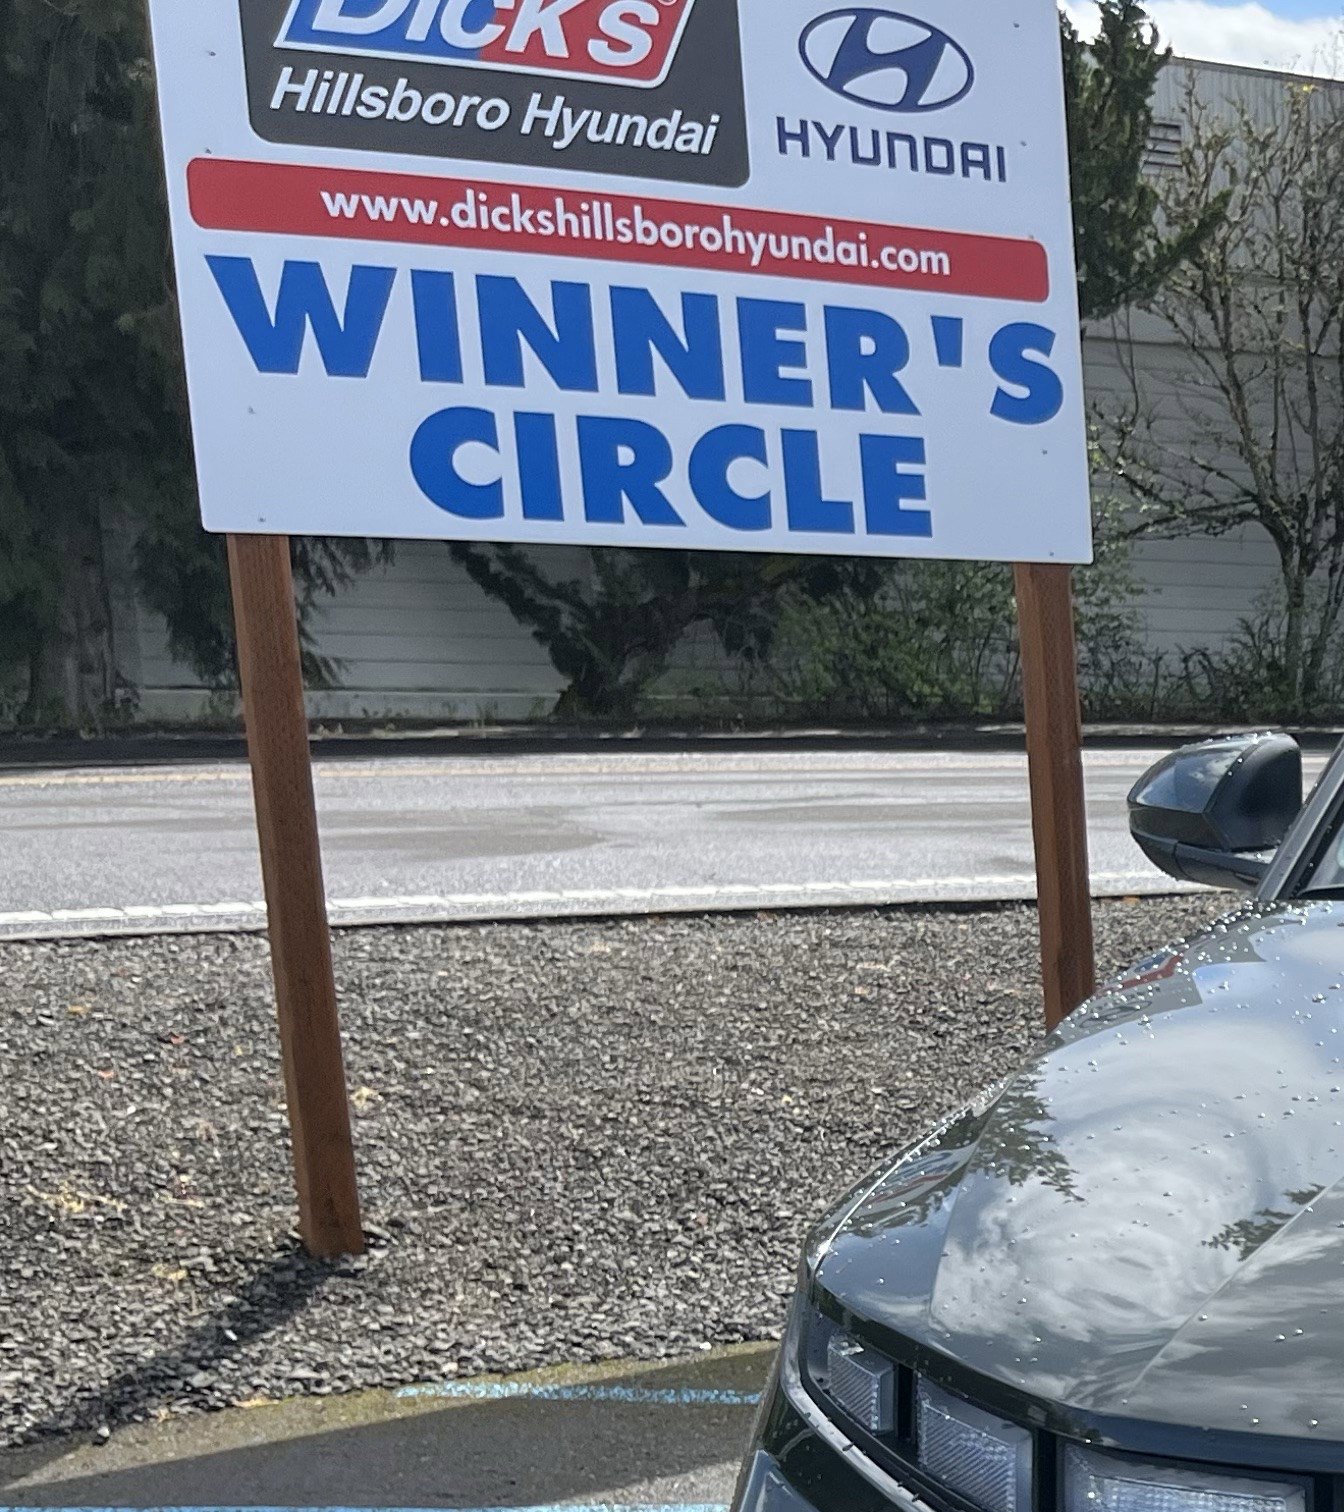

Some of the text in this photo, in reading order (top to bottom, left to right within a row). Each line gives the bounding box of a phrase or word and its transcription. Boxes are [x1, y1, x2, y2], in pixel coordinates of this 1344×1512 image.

[269, 67, 719, 156] Hillsboro Hyundai
[776, 117, 1006, 182] HYUNDAI
[320, 187, 951, 277] www.dickshillsborohyundai.com
[204, 254, 1064, 424] WINNER'S
[409, 405, 934, 537] CIRCLE
